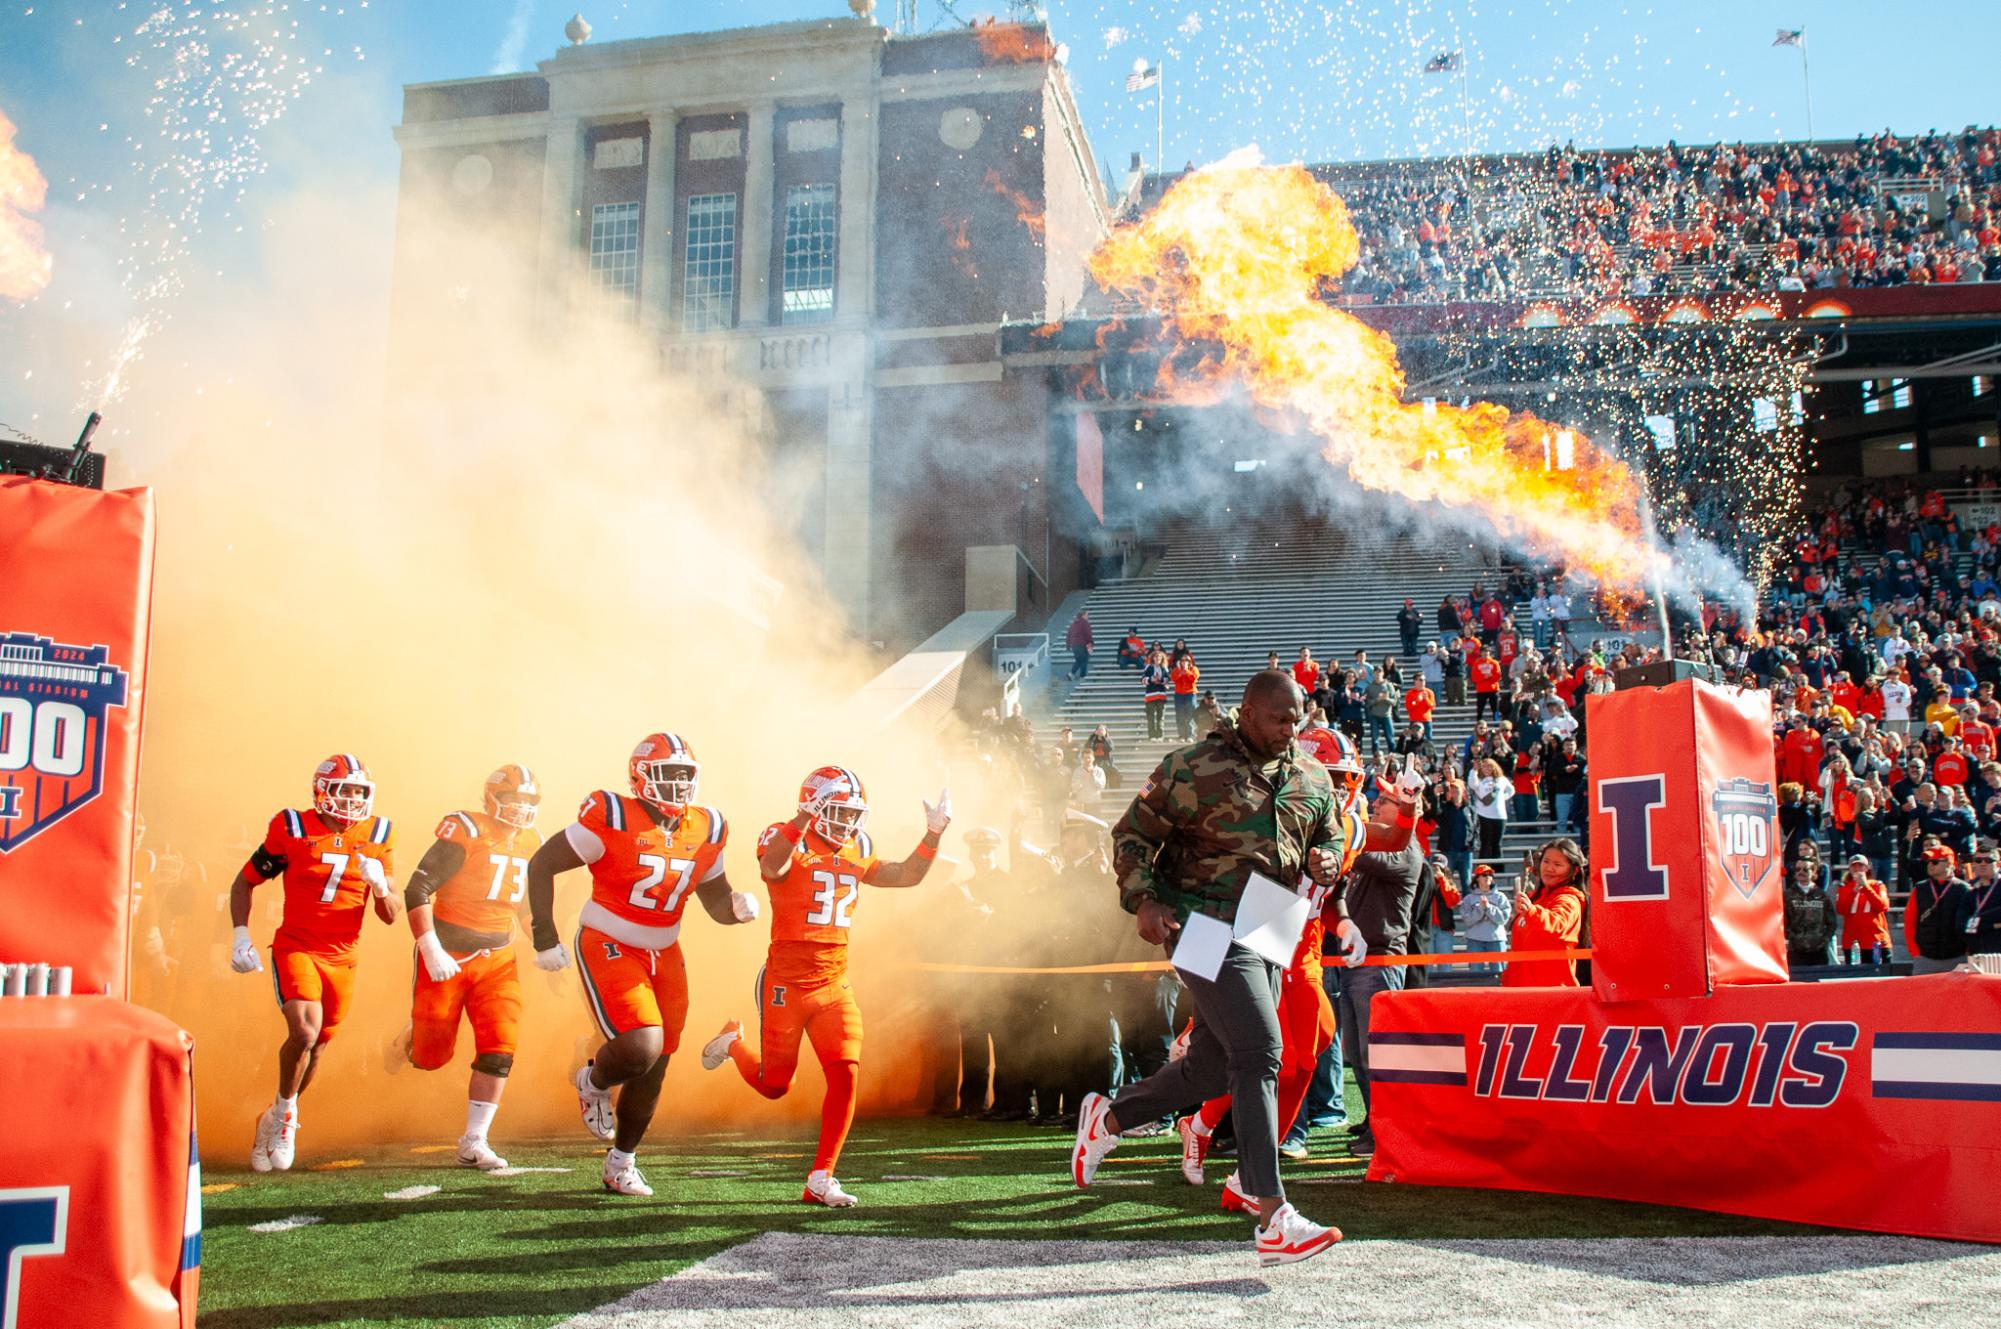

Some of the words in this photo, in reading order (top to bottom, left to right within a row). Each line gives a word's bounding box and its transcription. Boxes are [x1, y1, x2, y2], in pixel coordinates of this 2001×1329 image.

[28, 682, 89, 698] STADIUM
[1001, 661, 1022, 673] 101
[437, 821, 458, 838] 73
[1598, 773, 1670, 902] I
[1721, 813, 1767, 858] 100
[320, 852, 350, 904] 7
[486, 853, 529, 903] 73
[628, 853, 697, 912] 27
[806, 870, 858, 928] 32
[603, 942, 622, 960] I
[771, 985, 787, 1007] I
[1474, 1021, 1860, 1109] ILLINOIS
